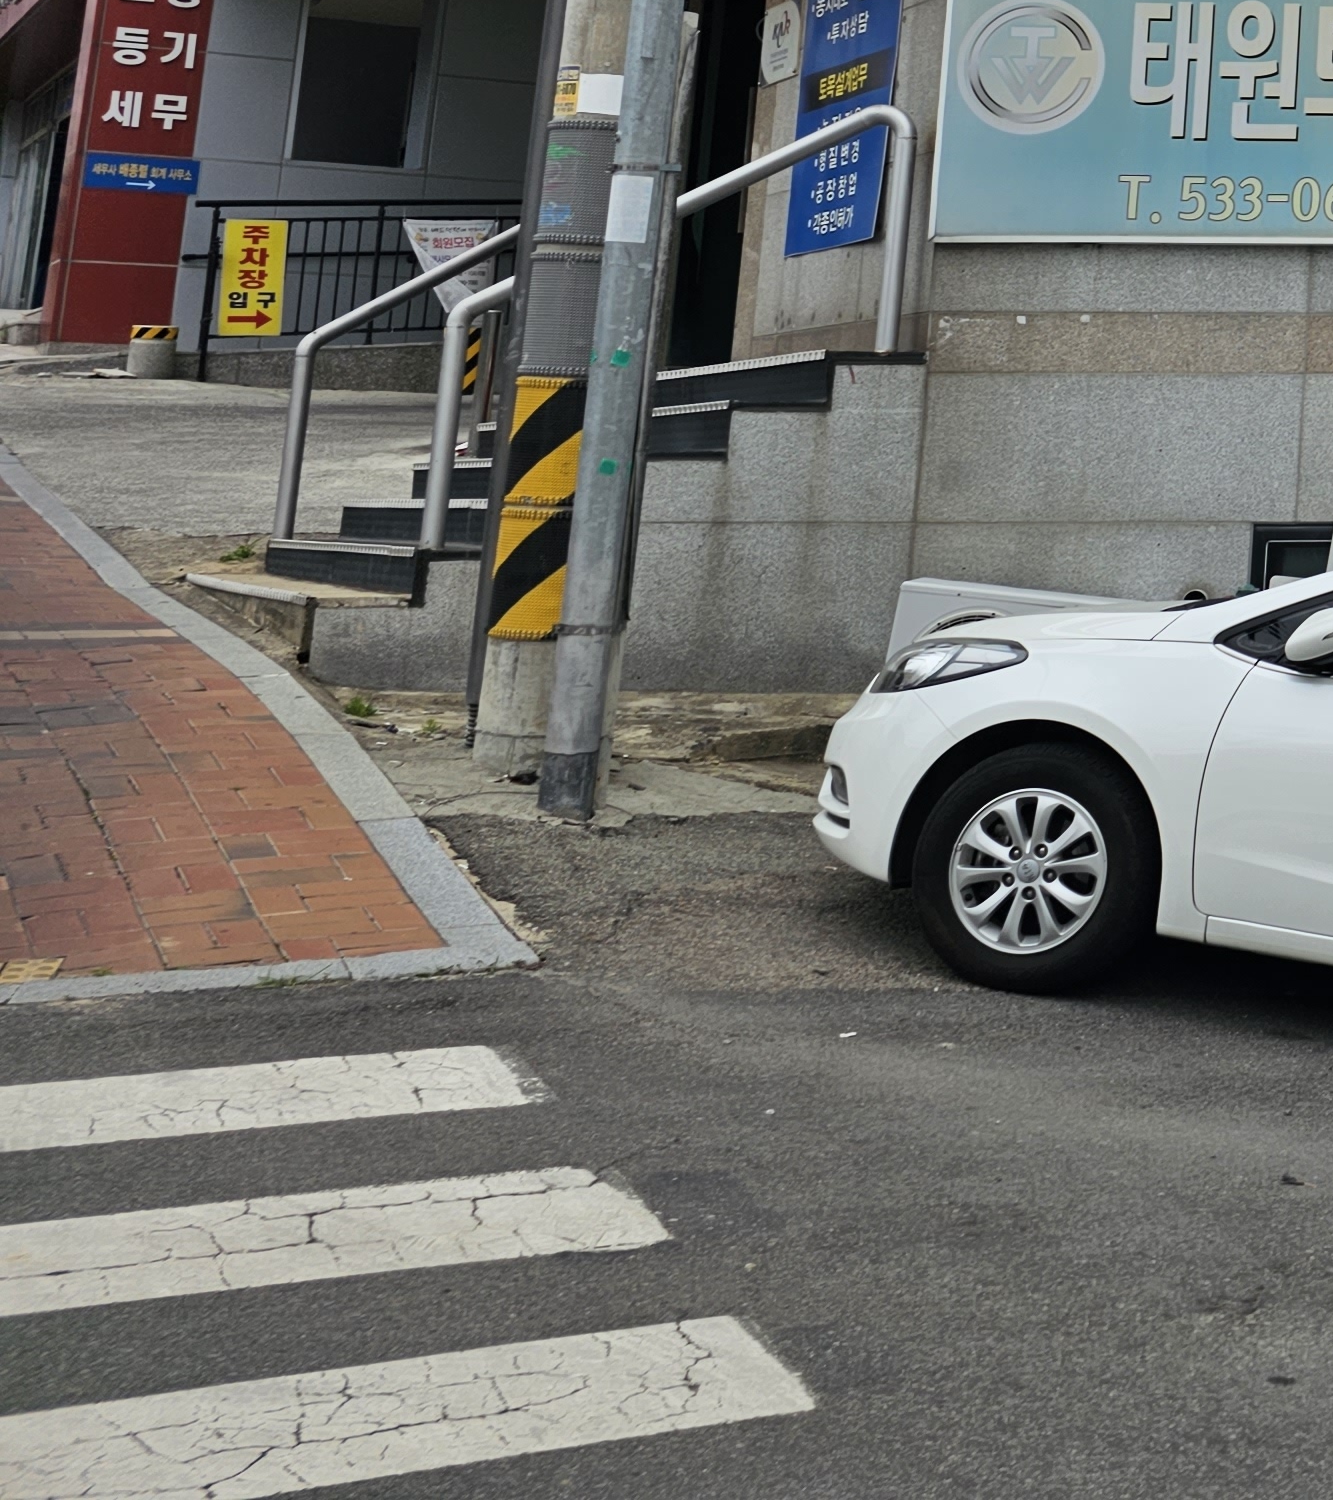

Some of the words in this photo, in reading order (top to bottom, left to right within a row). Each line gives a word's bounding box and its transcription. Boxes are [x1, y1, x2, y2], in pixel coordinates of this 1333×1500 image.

[112, 27, 198, 70] 등기
[101, 89, 189, 132] 세무
[1118, 174, 1162, 225] T.
[237, 224, 271, 290] 주차장
[227, 291, 278, 310] 입구
